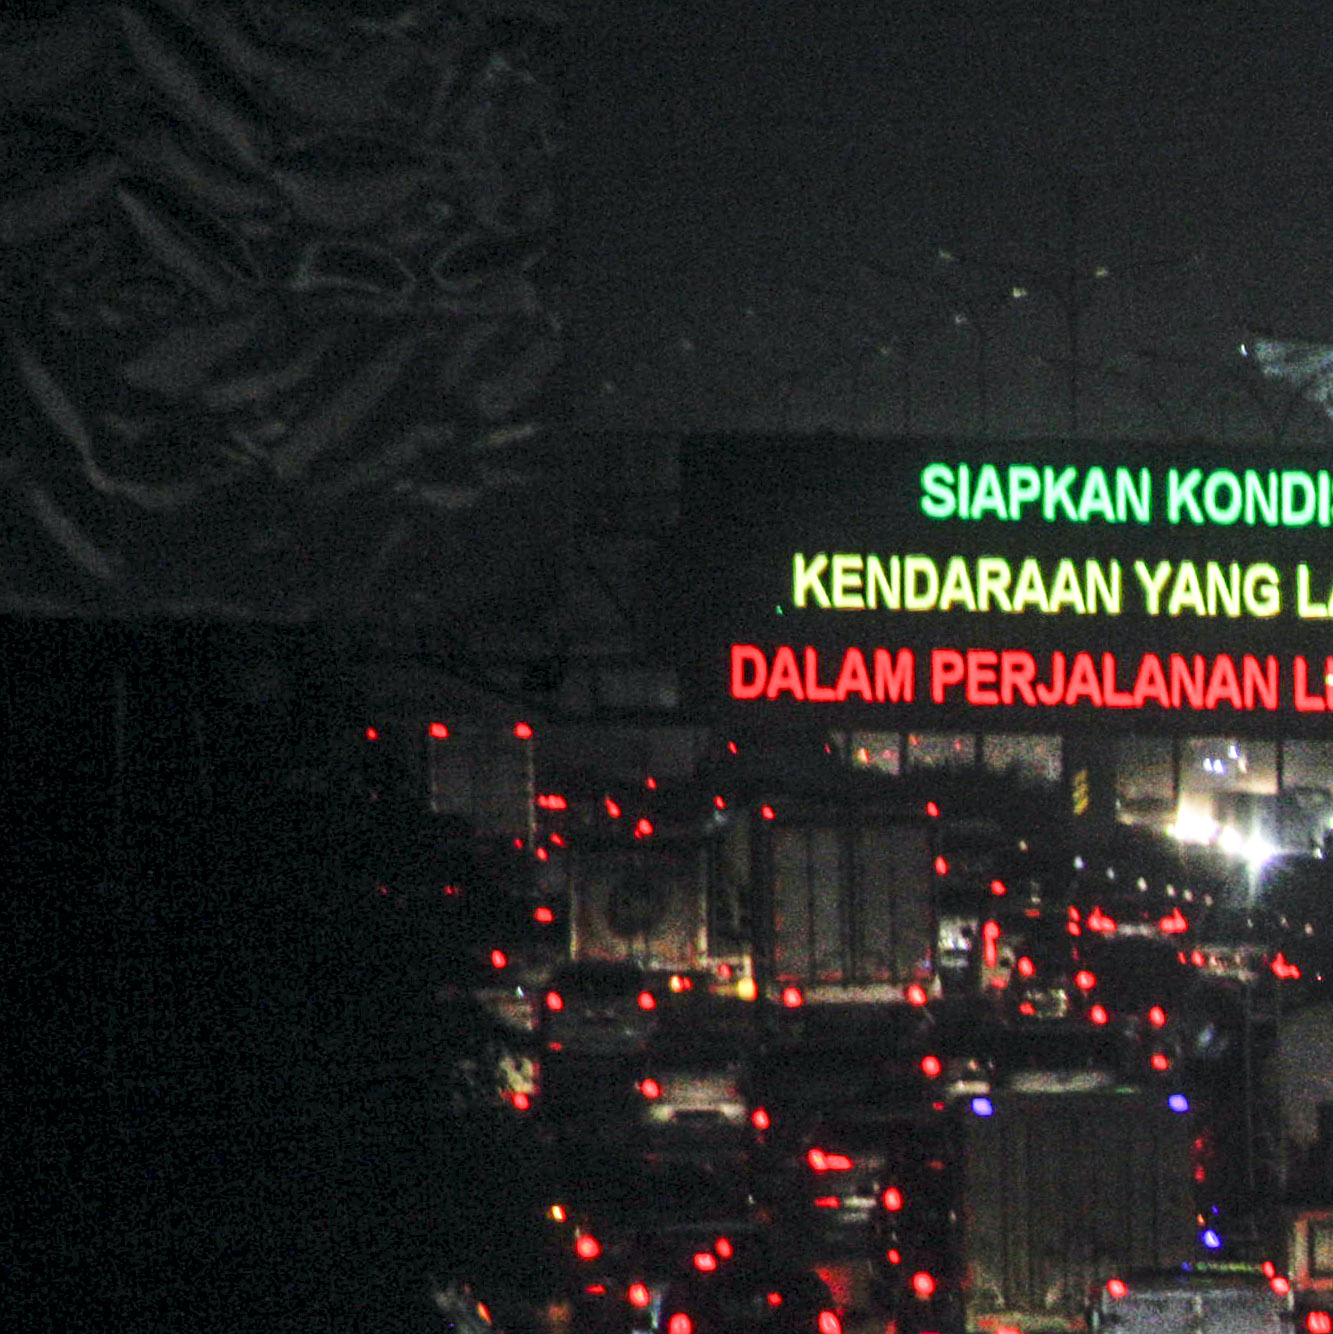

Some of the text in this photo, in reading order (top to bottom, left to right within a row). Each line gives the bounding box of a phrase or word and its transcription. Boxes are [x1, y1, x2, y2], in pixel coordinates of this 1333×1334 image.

[921, 463, 1152, 523] SIAPKAN
[792, 552, 1122, 614] KENDARAAN
[1133, 559, 1281, 617] YANG
[730, 643, 915, 703] DALAM
[929, 649, 1280, 711] PERJALANAN
